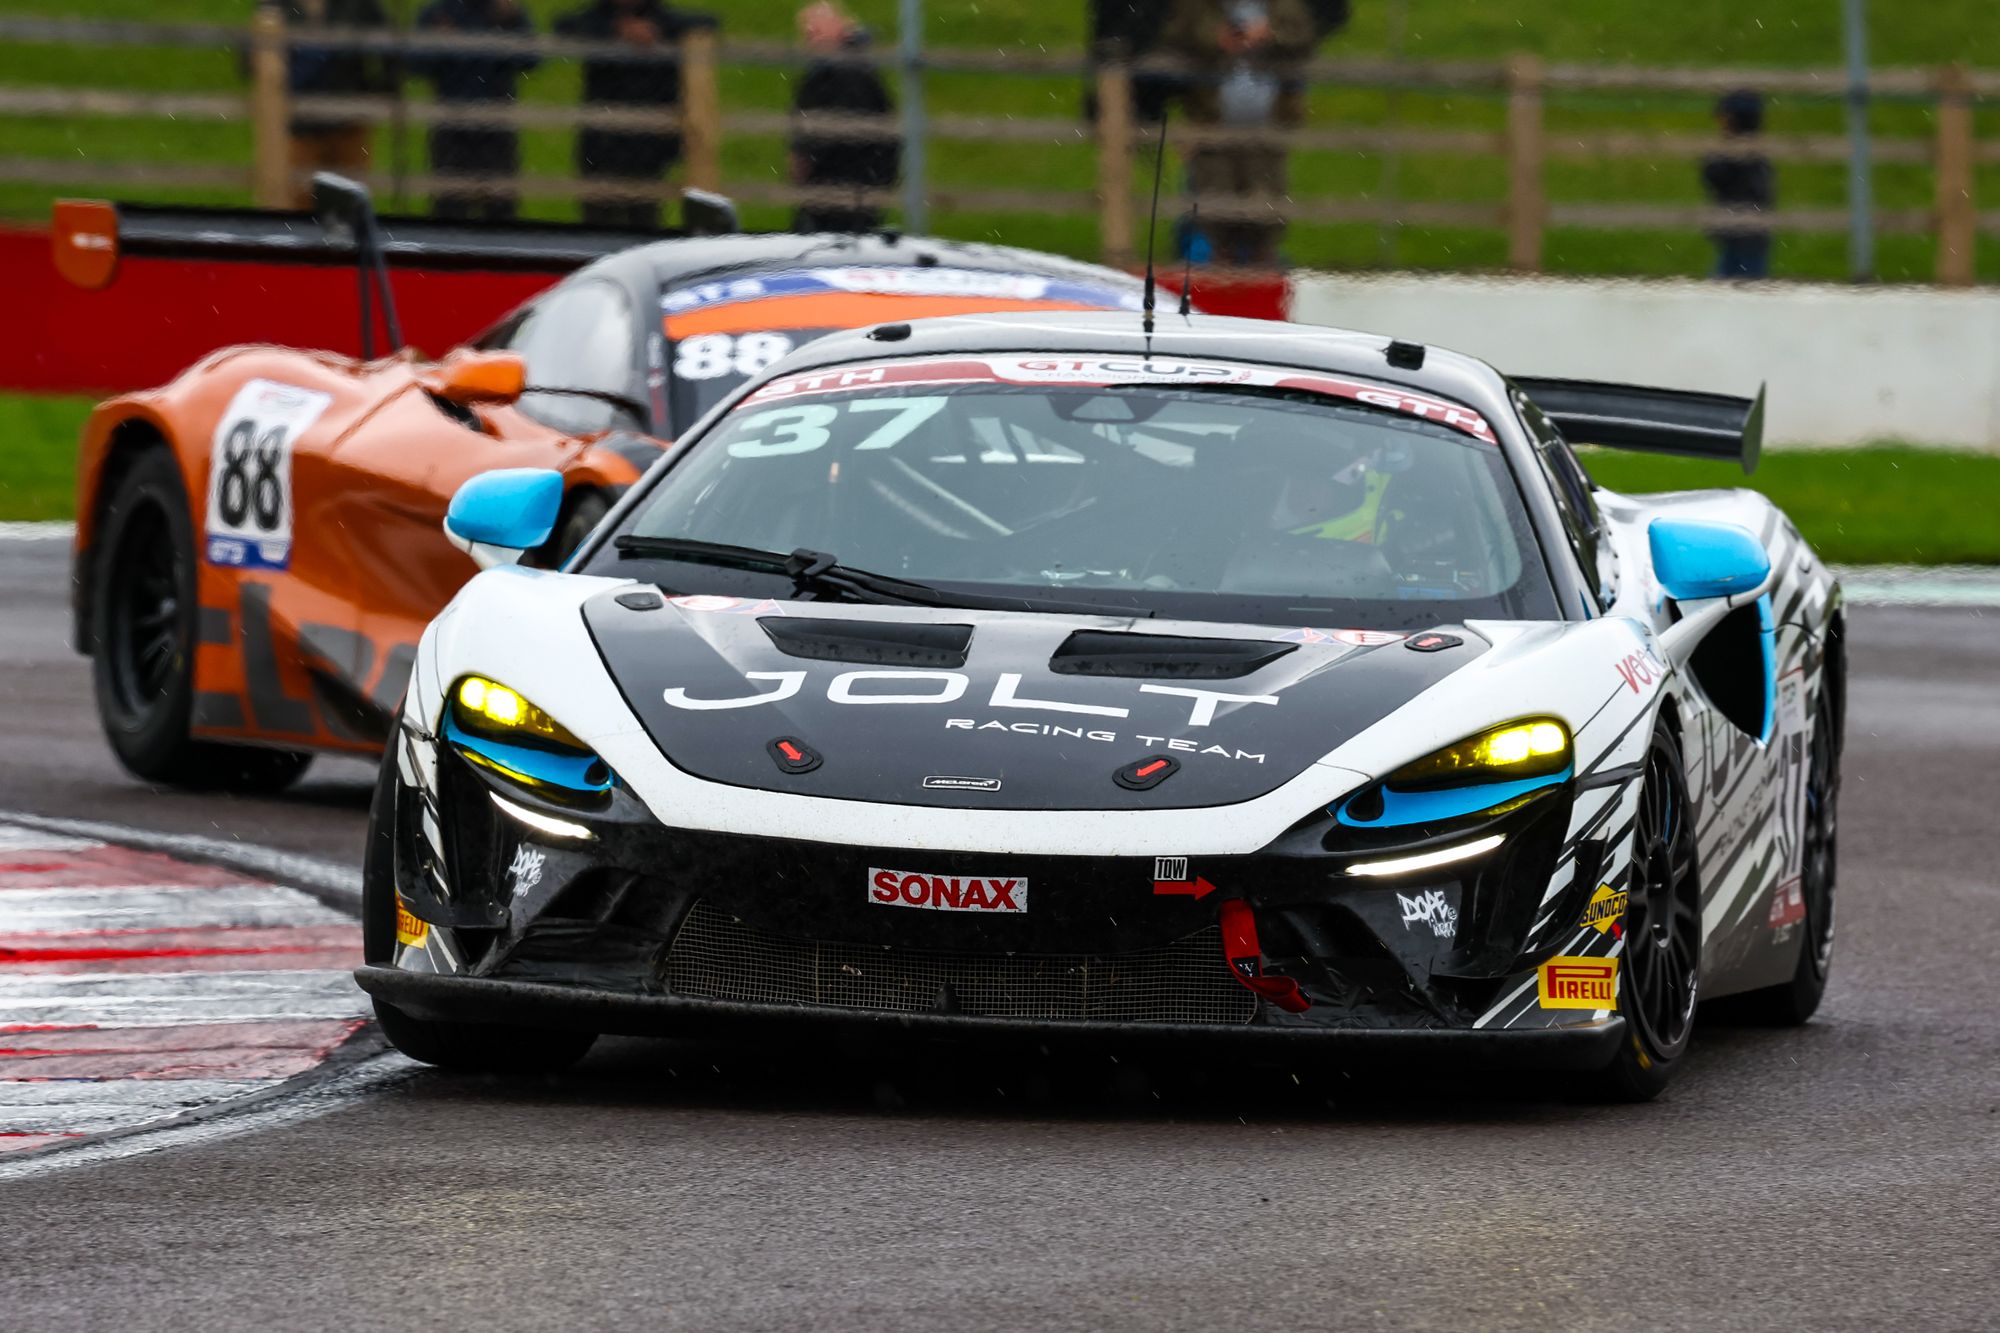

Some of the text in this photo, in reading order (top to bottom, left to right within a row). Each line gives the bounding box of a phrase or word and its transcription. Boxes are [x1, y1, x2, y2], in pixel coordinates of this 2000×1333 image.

[673, 331, 794, 380] 88
[727, 396, 949, 459] 37
[1355, 391, 1488, 433] GTH
[218, 419, 290, 530] 88
[663, 671, 1279, 727] JOLT
[945, 718, 1265, 764] RACING TEAM
[873, 870, 1018, 910] SONAX
[1157, 859, 1186, 881] TOW
[1582, 894, 1626, 924] SUNOCO
[1547, 965, 1612, 1000] PIRELLI
